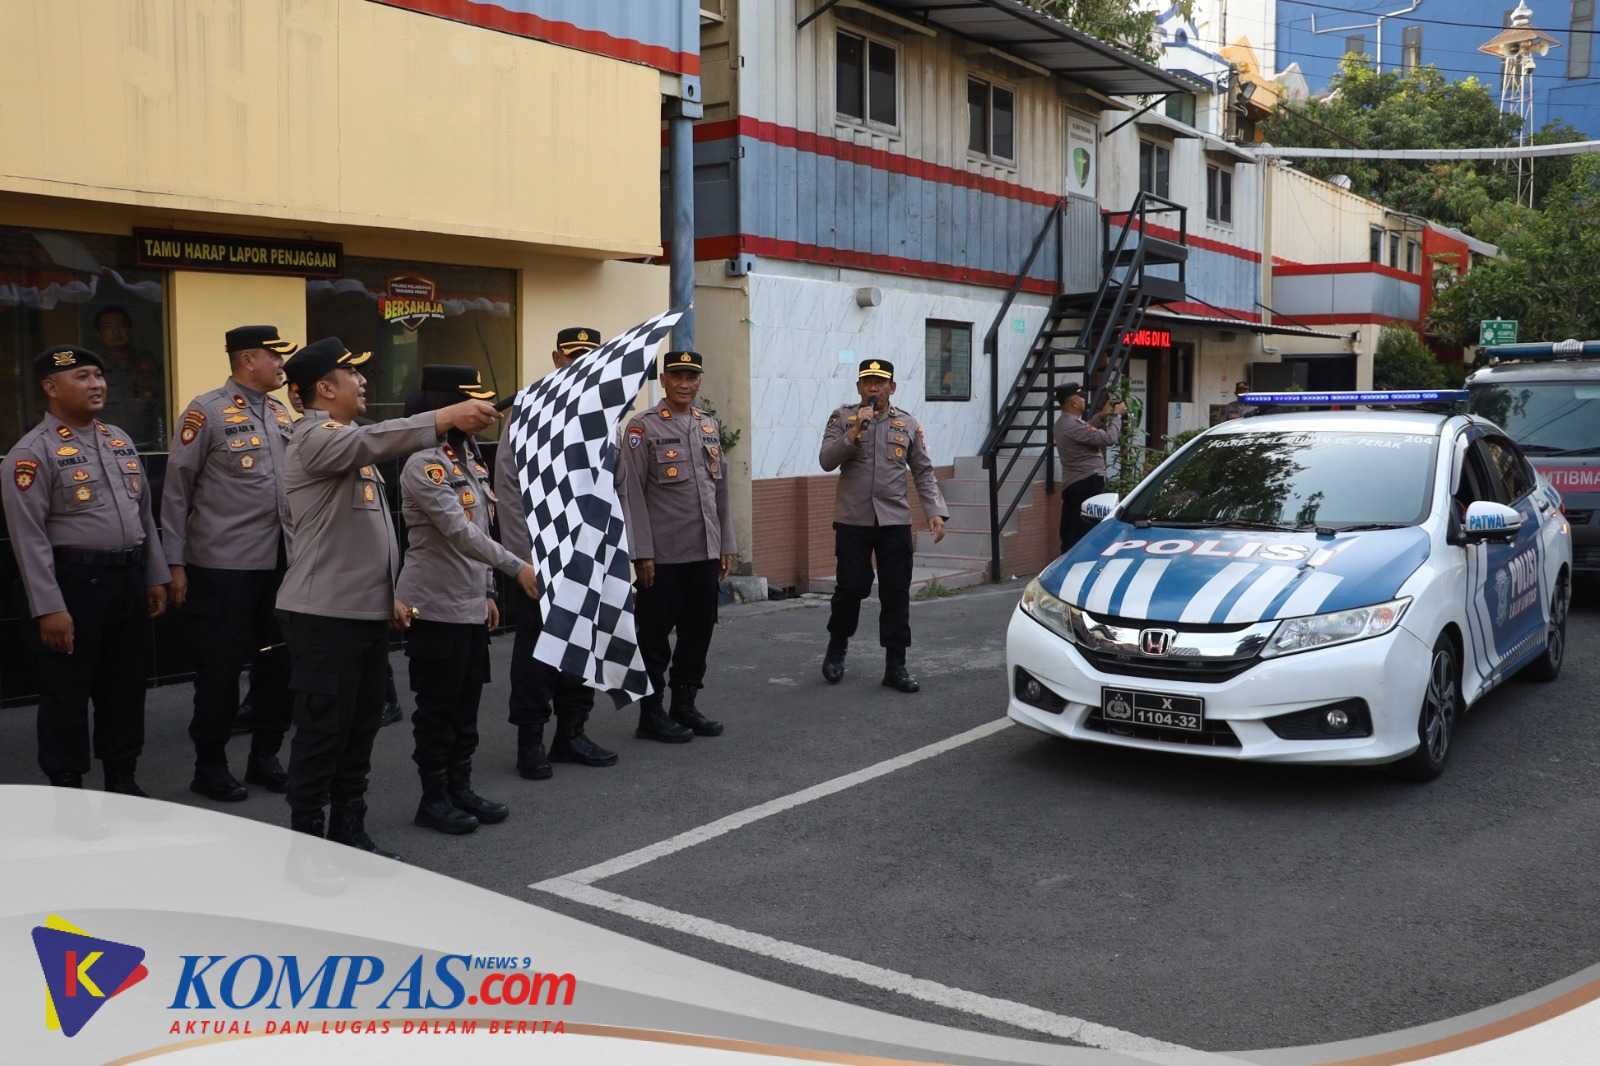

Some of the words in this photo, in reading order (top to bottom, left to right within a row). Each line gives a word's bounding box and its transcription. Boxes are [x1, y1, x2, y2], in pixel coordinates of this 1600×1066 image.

[144, 239, 181, 258] TAMU
[184, 242, 226, 261] HARAP
[229, 246, 268, 264] LAPOR
[271, 249, 337, 268] PENJAGAAN
[384, 300, 444, 320] BERSAHAJA
[1208, 438, 1254, 449] POLRES
[1470, 514, 1505, 530] PATWAL
[1101, 539, 1336, 566] POLISI
[1508, 548, 1537, 600] POLISI
[1161, 698, 1173, 710] X
[1137, 710, 1198, 728] 1104-32
